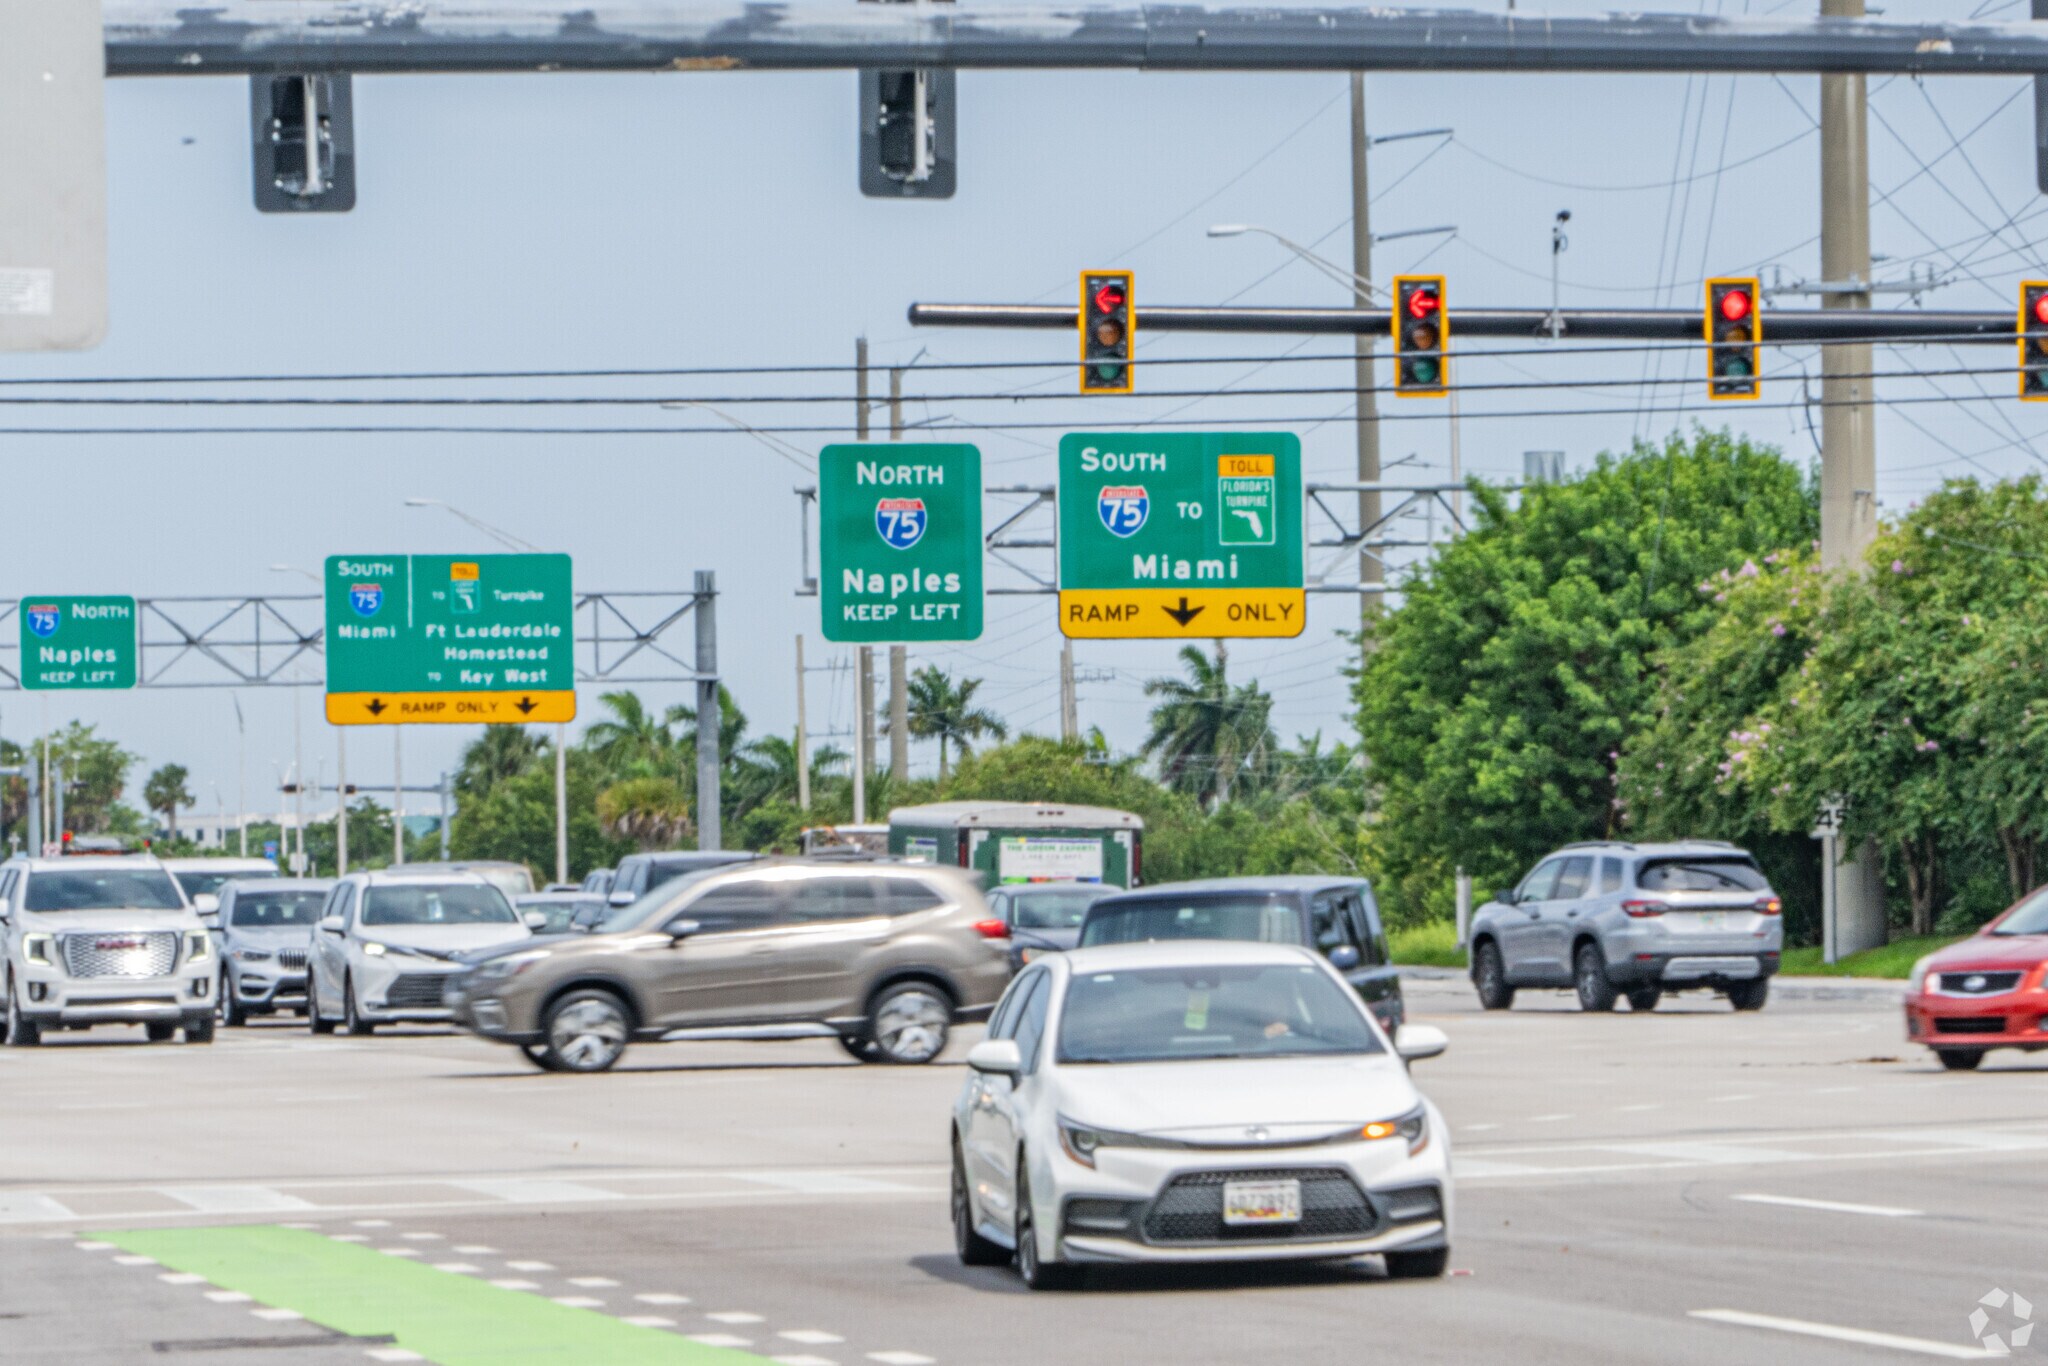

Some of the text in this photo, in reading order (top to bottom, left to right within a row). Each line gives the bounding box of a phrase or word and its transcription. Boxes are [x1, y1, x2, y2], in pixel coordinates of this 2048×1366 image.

[1081, 447, 1166, 471] SOUTH
[1229, 460, 1264, 473] TOLL
[856, 461, 944, 485] NORTH
[1222, 481, 1271, 492] FLORIDA'S
[1226, 496, 1268, 507] TURNPIKE
[1103, 500, 1203, 527] 75 TO
[881, 512, 920, 539] 75
[338, 560, 394, 577] SOUTH
[1133, 554, 1238, 579] Miami
[843, 568, 961, 599] Naples
[356, 593, 377, 609] 75
[494, 590, 544, 602] Turnpike
[72, 603, 129, 619] NORTH
[843, 604, 961, 621] KEEP LEFT
[1069, 603, 1294, 622] RAMP ONLY
[33, 613, 55, 630] 75
[338, 624, 396, 638] Miami
[426, 624, 561, 638] Ft Lauderdale
[40, 646, 116, 665] Naples
[444, 647, 548, 660] Homestead
[40, 671, 115, 682] KEEP LEFT
[460, 670, 494, 687] Key
[505, 669, 547, 683] West
[401, 702, 498, 713] RAMP ONLY
